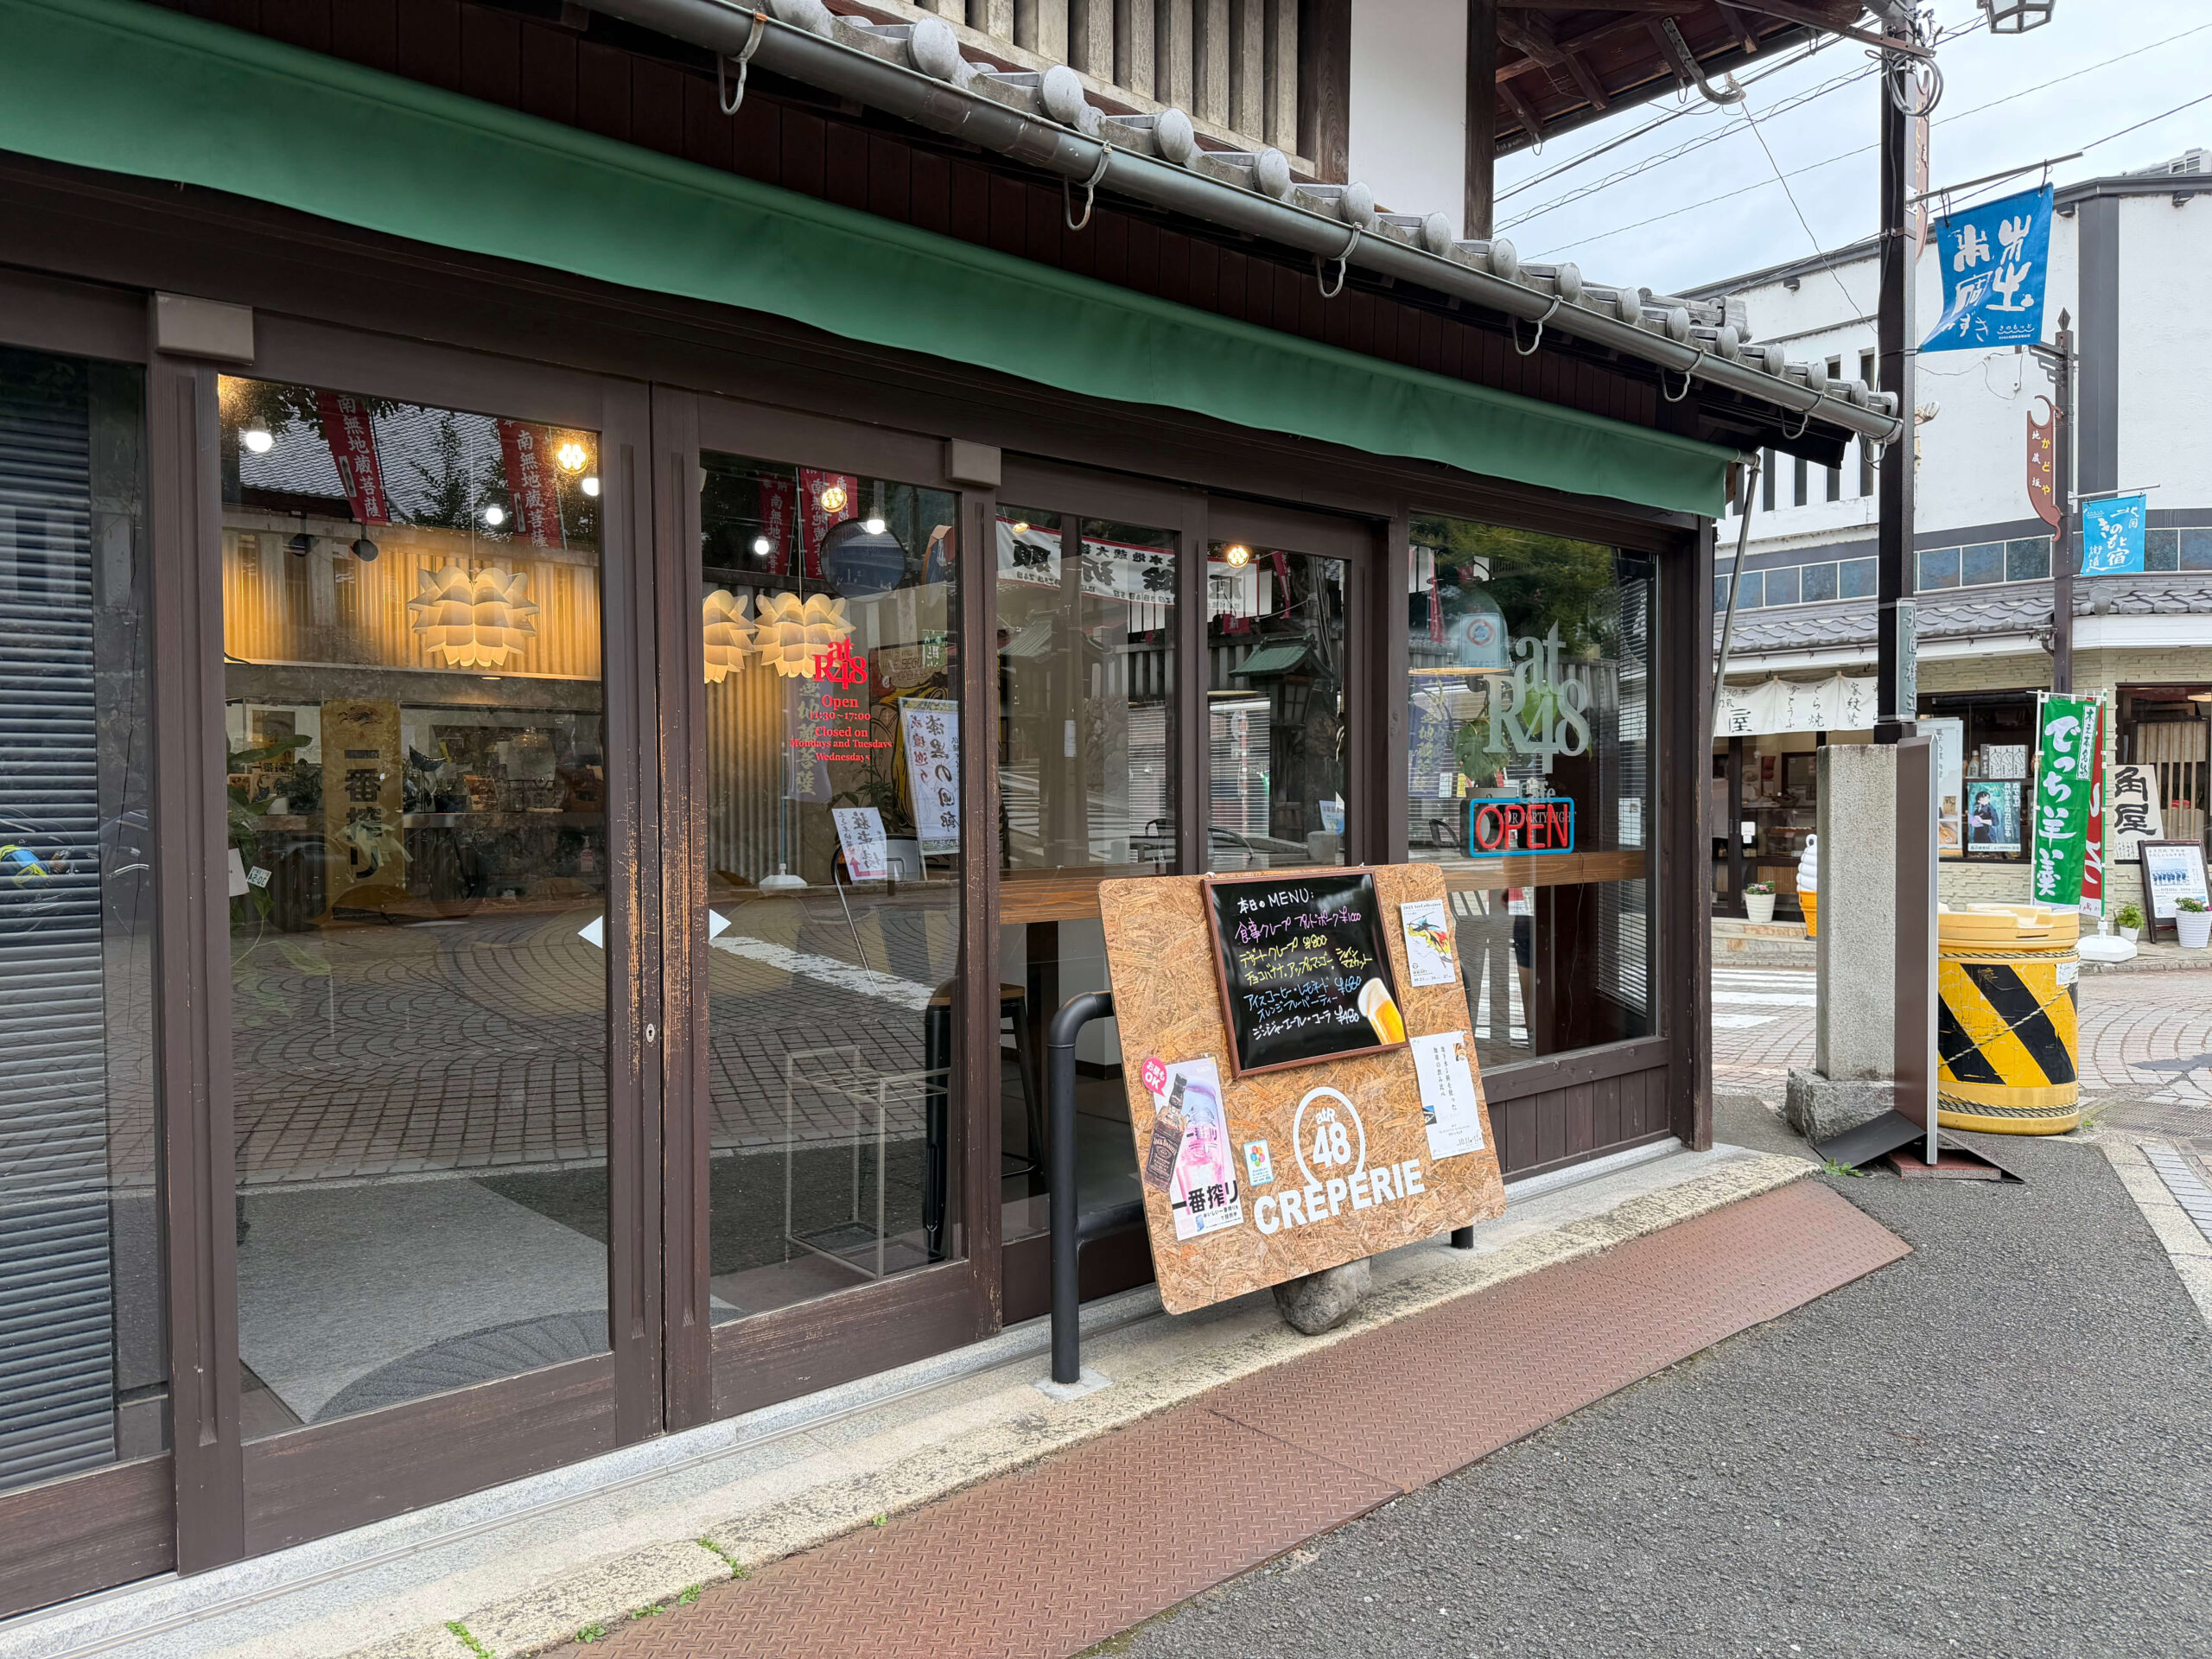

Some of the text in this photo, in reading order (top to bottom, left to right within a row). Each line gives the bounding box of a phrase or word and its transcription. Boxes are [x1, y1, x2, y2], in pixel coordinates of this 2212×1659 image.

[337, 396, 381, 518] 南無地蔵菩薩
[2032, 430, 2042, 487] 地蔵坂
[2042, 438, 2050, 496] かどや
[517, 429, 549, 547] 南無地蔵菩薩
[828, 636, 855, 662] at
[1515, 620, 1567, 691] at
[811, 654, 868, 690] R48
[822, 695, 859, 710] Open
[1480, 674, 1592, 774] R48
[1808, 683, 1825, 728] どら焼
[789, 738, 831, 749] Mondays
[815, 726, 868, 737] Closed on
[2079, 706, 2095, 779] 木之本名物
[816, 752, 871, 762] Wednesdays
[2037, 715, 2082, 897] でっち羊羹
[2114, 766, 2157, 836] 角屋
[1476, 804, 1567, 850] OPEN
[1235, 917, 1291, 944] 食事クレープ
[1239, 936, 1299, 969] デザートクレープ
[1145, 1071, 1160, 1089] OK
[1313, 1122, 1351, 1167] 48
[1172, 1180, 1238, 1214] 一番搾り
[1254, 1159, 1426, 1235] CREPERIE
